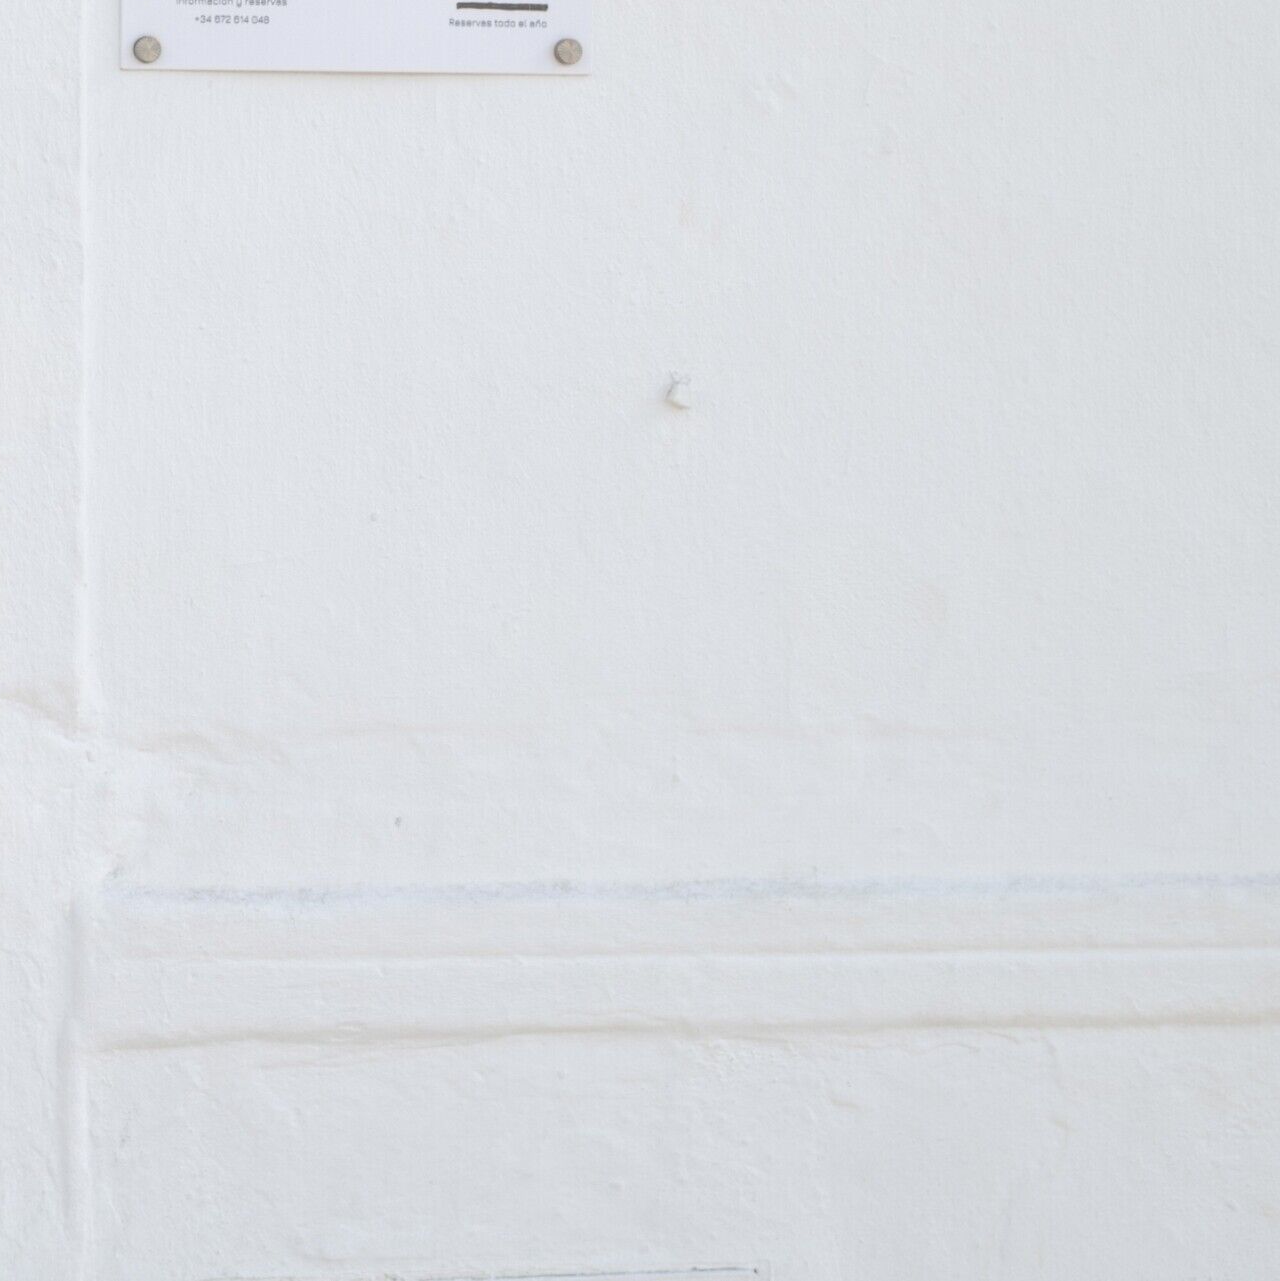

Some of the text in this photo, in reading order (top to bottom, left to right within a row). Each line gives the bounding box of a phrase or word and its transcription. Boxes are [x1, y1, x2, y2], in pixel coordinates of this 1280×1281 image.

[448, 17, 548, 29] Reservas todo el año
